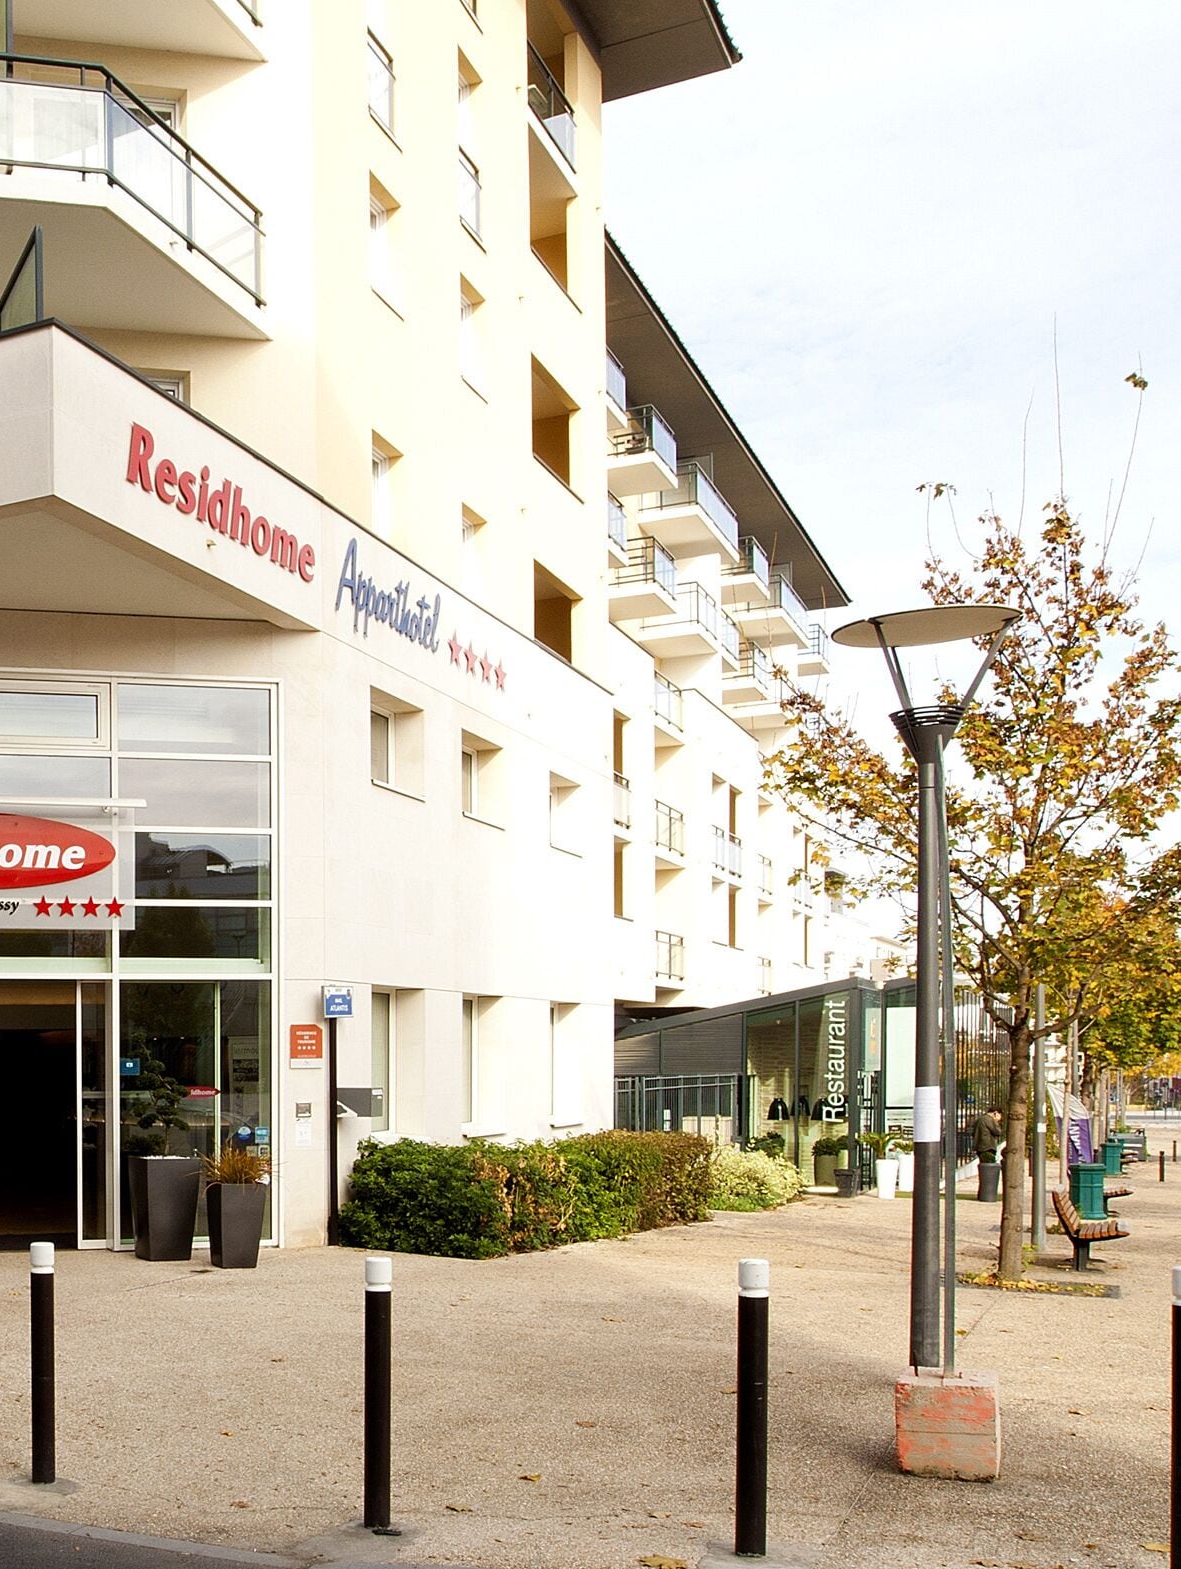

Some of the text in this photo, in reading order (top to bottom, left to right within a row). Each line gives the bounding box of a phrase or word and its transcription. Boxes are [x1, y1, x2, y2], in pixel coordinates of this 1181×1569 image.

[125, 421, 442, 654] Residhome Apparthotel
[822, 1000, 846, 1123] Restaurant
